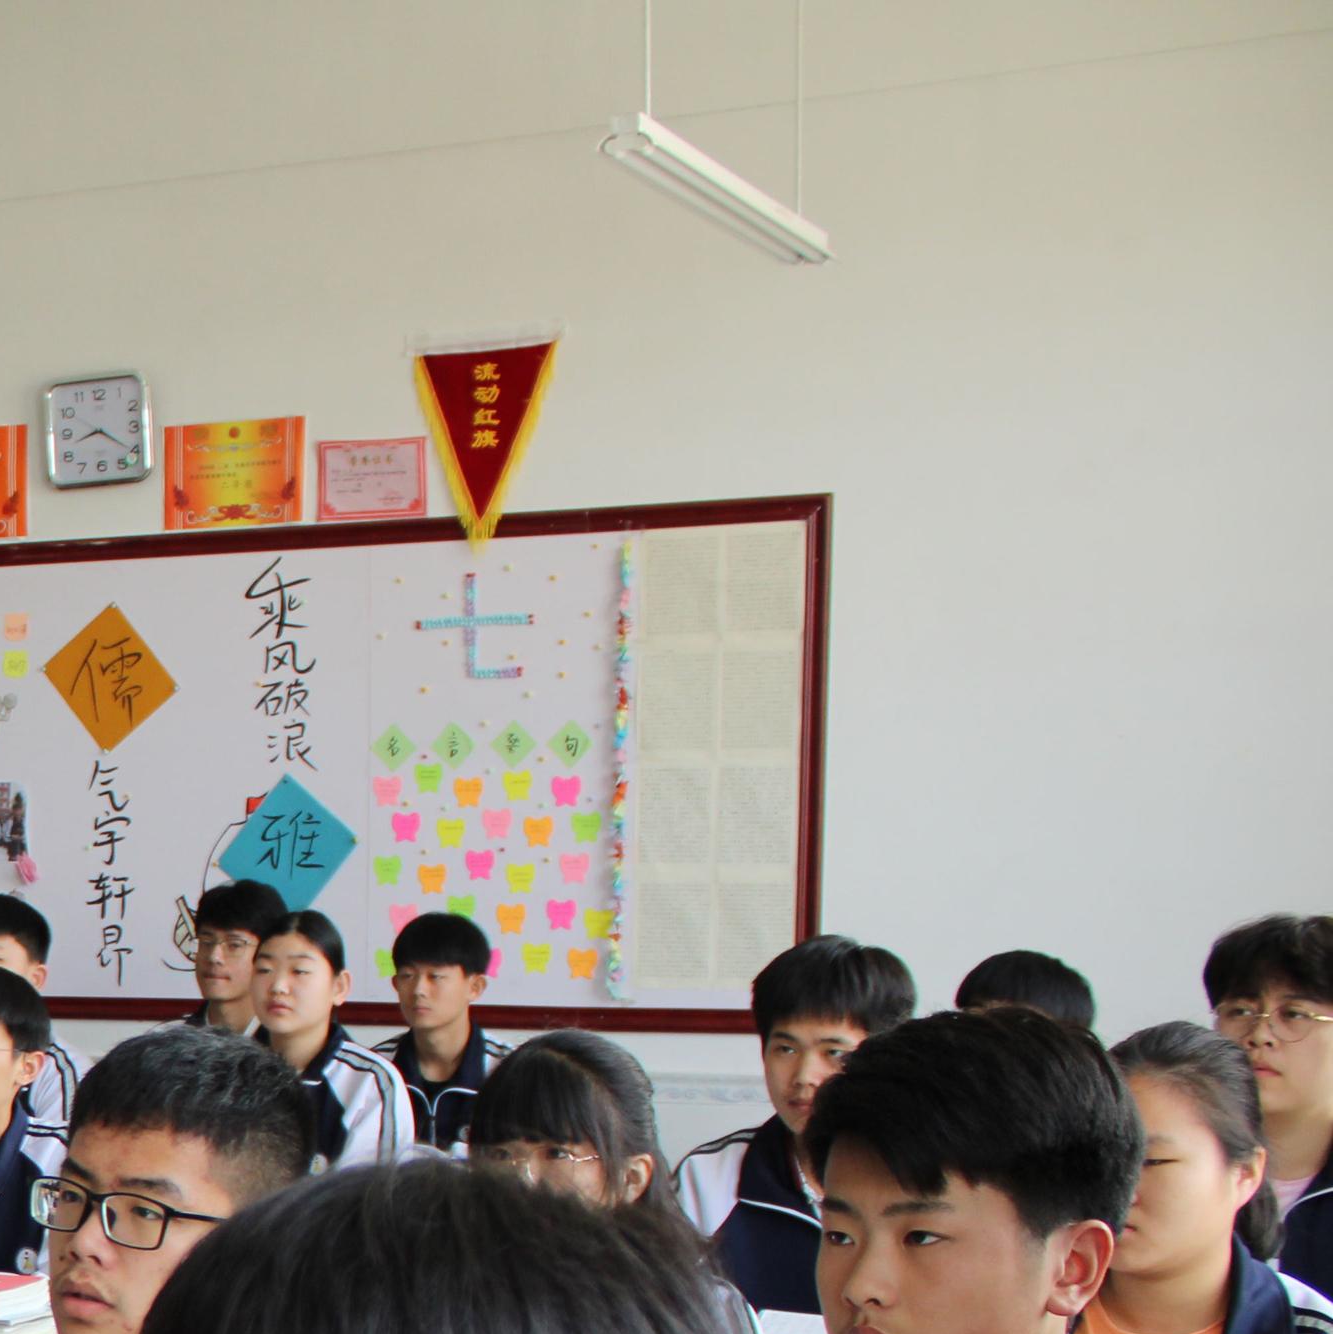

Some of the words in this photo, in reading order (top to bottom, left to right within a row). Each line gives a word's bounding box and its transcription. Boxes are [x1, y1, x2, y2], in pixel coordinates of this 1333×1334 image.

[74, 391, 84, 403] 11
[92, 388, 106, 401] 12
[128, 399, 138, 412] 2
[471, 362, 501, 448] 流动红旗
[61, 407, 76, 419] 10
[128, 420, 140, 433] 3
[61, 428, 73, 440] 9
[129, 444, 140, 456] 4
[63, 451, 74, 463] 8
[76, 462, 87, 474] 7
[97, 460, 108, 472] 6
[117, 458, 128, 470] 5
[244, 556, 318, 772] 乘风破浪
[70, 636, 143, 725] 儒
[256, 809, 325, 879] 雅
[86, 760, 135, 987] 气宇轩昂
